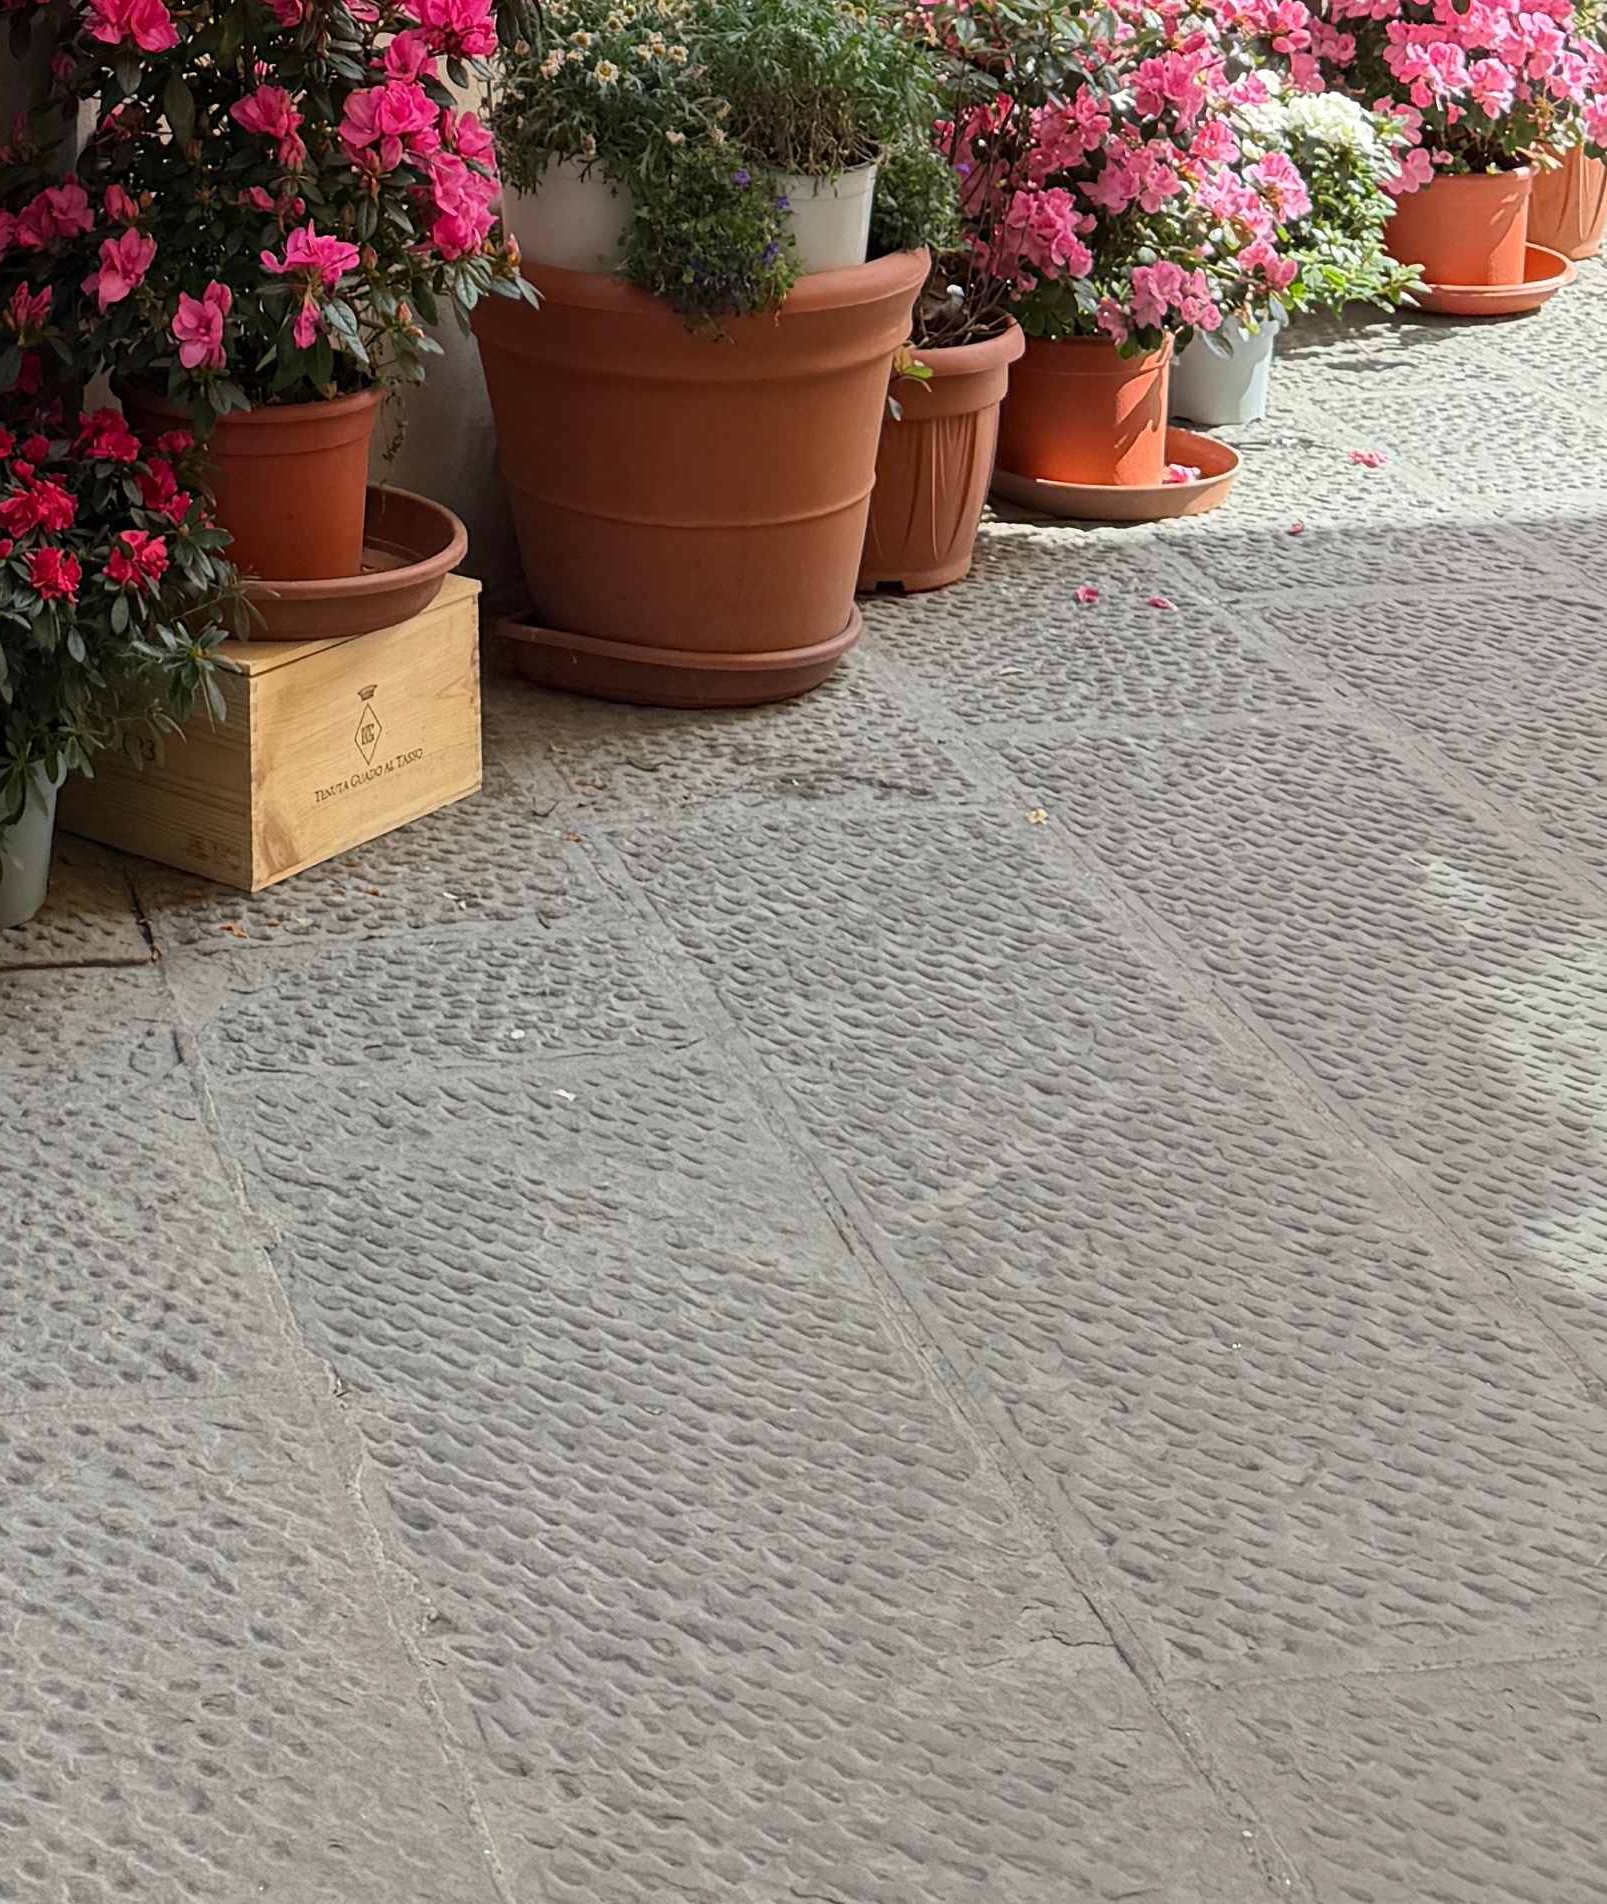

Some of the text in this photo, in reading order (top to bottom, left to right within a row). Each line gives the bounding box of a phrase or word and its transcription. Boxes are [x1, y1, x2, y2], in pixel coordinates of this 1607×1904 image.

[314, 748, 423, 803] TENUTA GUADO AL TASSO
